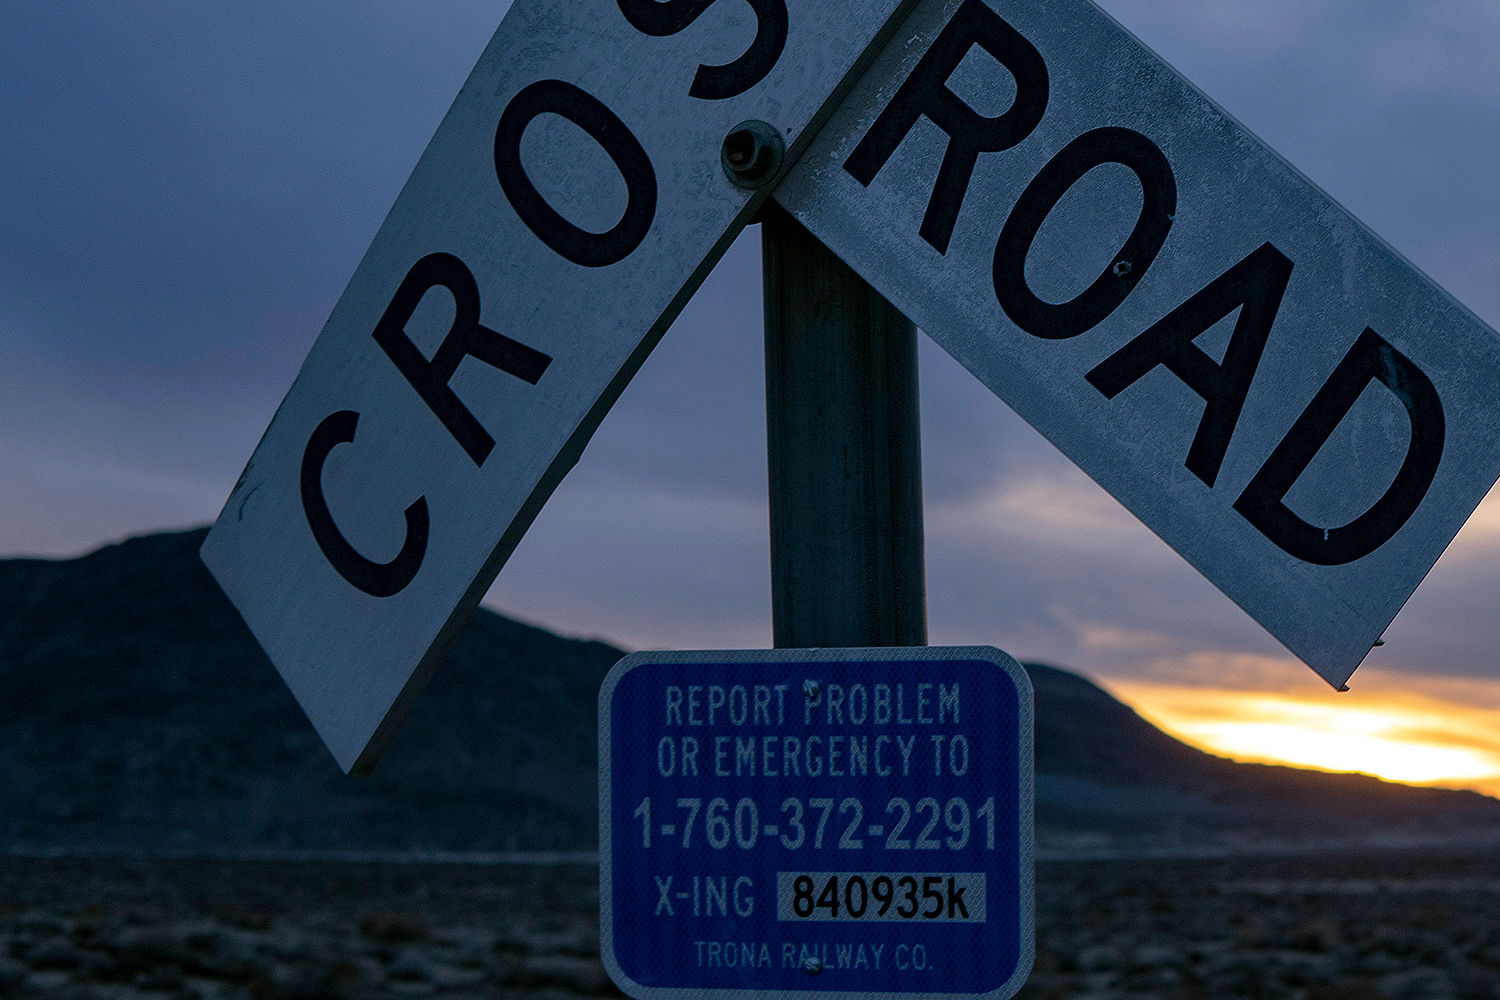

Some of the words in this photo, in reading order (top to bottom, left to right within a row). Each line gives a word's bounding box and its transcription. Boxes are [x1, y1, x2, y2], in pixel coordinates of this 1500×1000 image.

[666, 685, 788, 726] REPORT
[803, 682, 960, 725] PROBLEM
[657, 737, 698, 777] OR
[715, 735, 915, 777] EMERGENCY
[931, 734, 969, 776] TO
[633, 796, 996, 850] 1-760-372-2291
[654, 875, 754, 917] X-ING
[694, 941, 772, 968] TRONA
[895, 944, 933, 971] CO.
